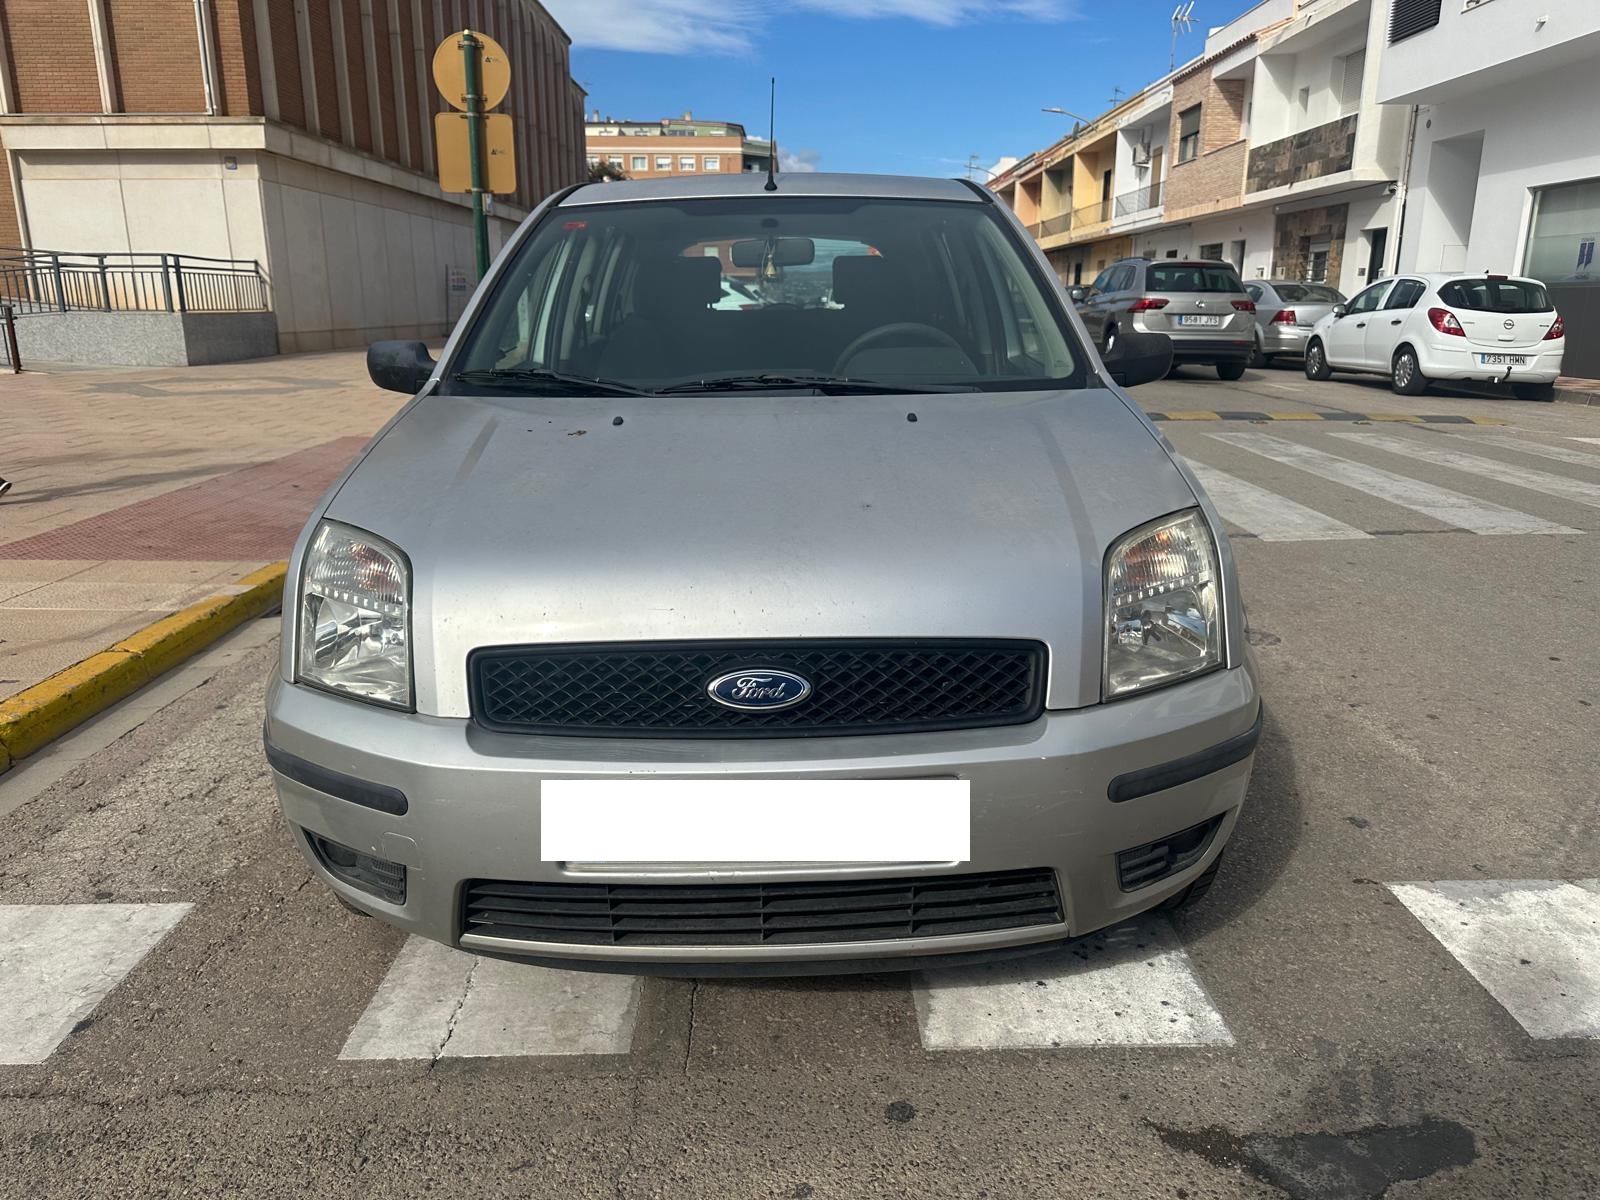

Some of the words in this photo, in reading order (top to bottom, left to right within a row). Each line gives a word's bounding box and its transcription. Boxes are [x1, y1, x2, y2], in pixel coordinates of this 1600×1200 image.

[1184, 316, 1202, 324] 9581
[1486, 354, 1506, 363] 7351
[1510, 355, 1525, 364] HMN
[731, 677, 786, 700] Ford
